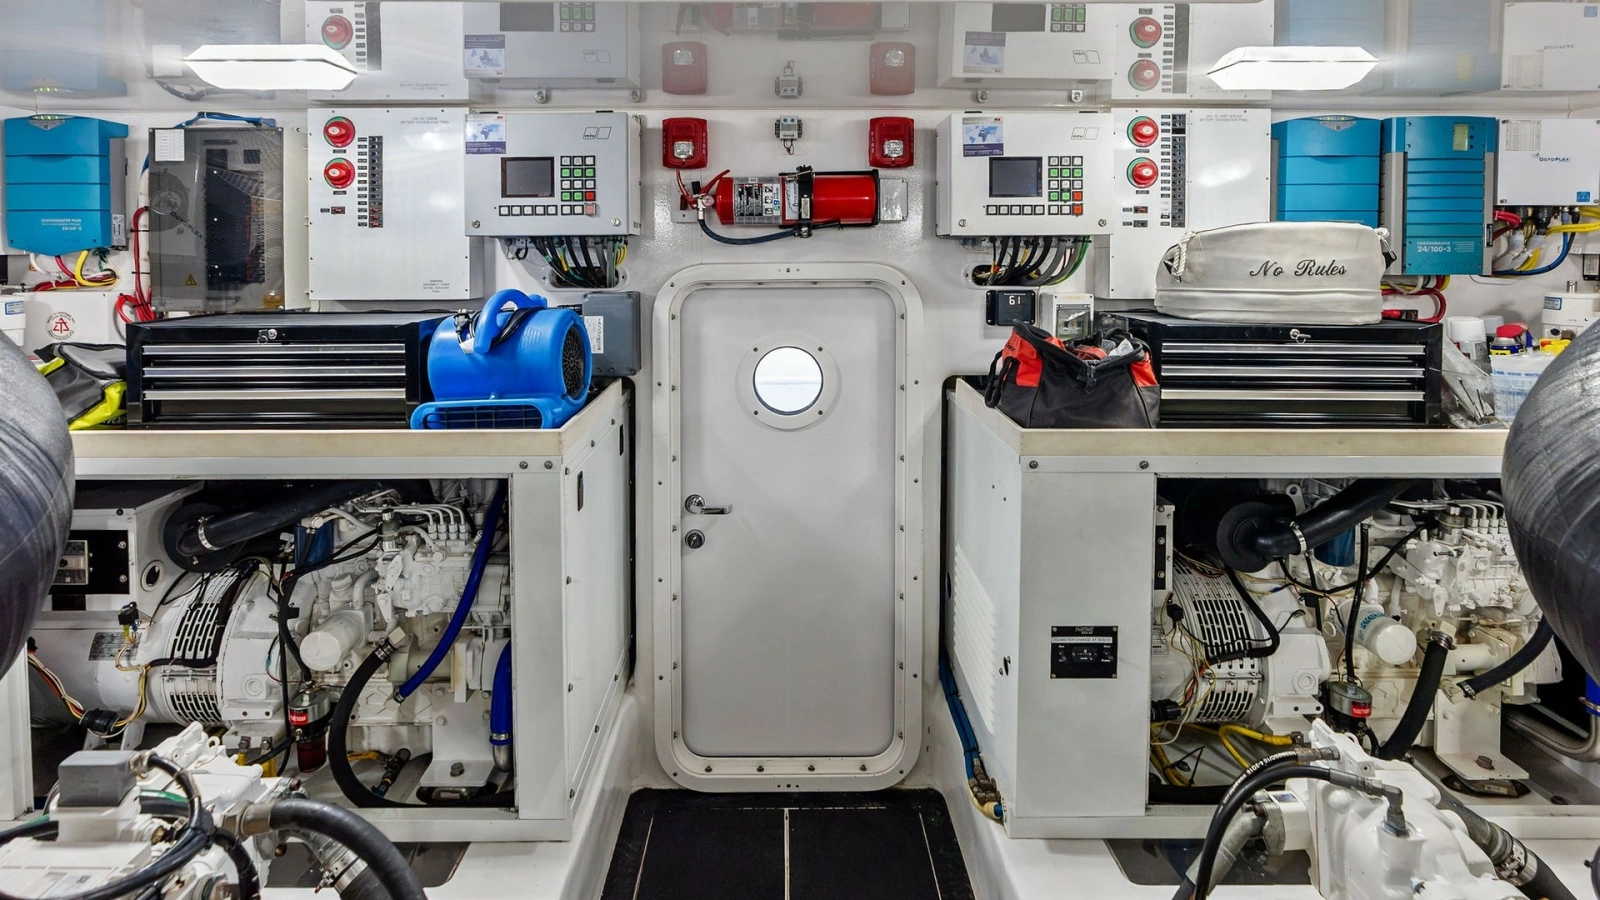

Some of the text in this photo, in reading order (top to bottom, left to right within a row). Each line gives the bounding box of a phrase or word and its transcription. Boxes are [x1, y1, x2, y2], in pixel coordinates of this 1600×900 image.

[1249, 259, 1347, 276] No Rules
[1009, 295, 1021, 306] 61
